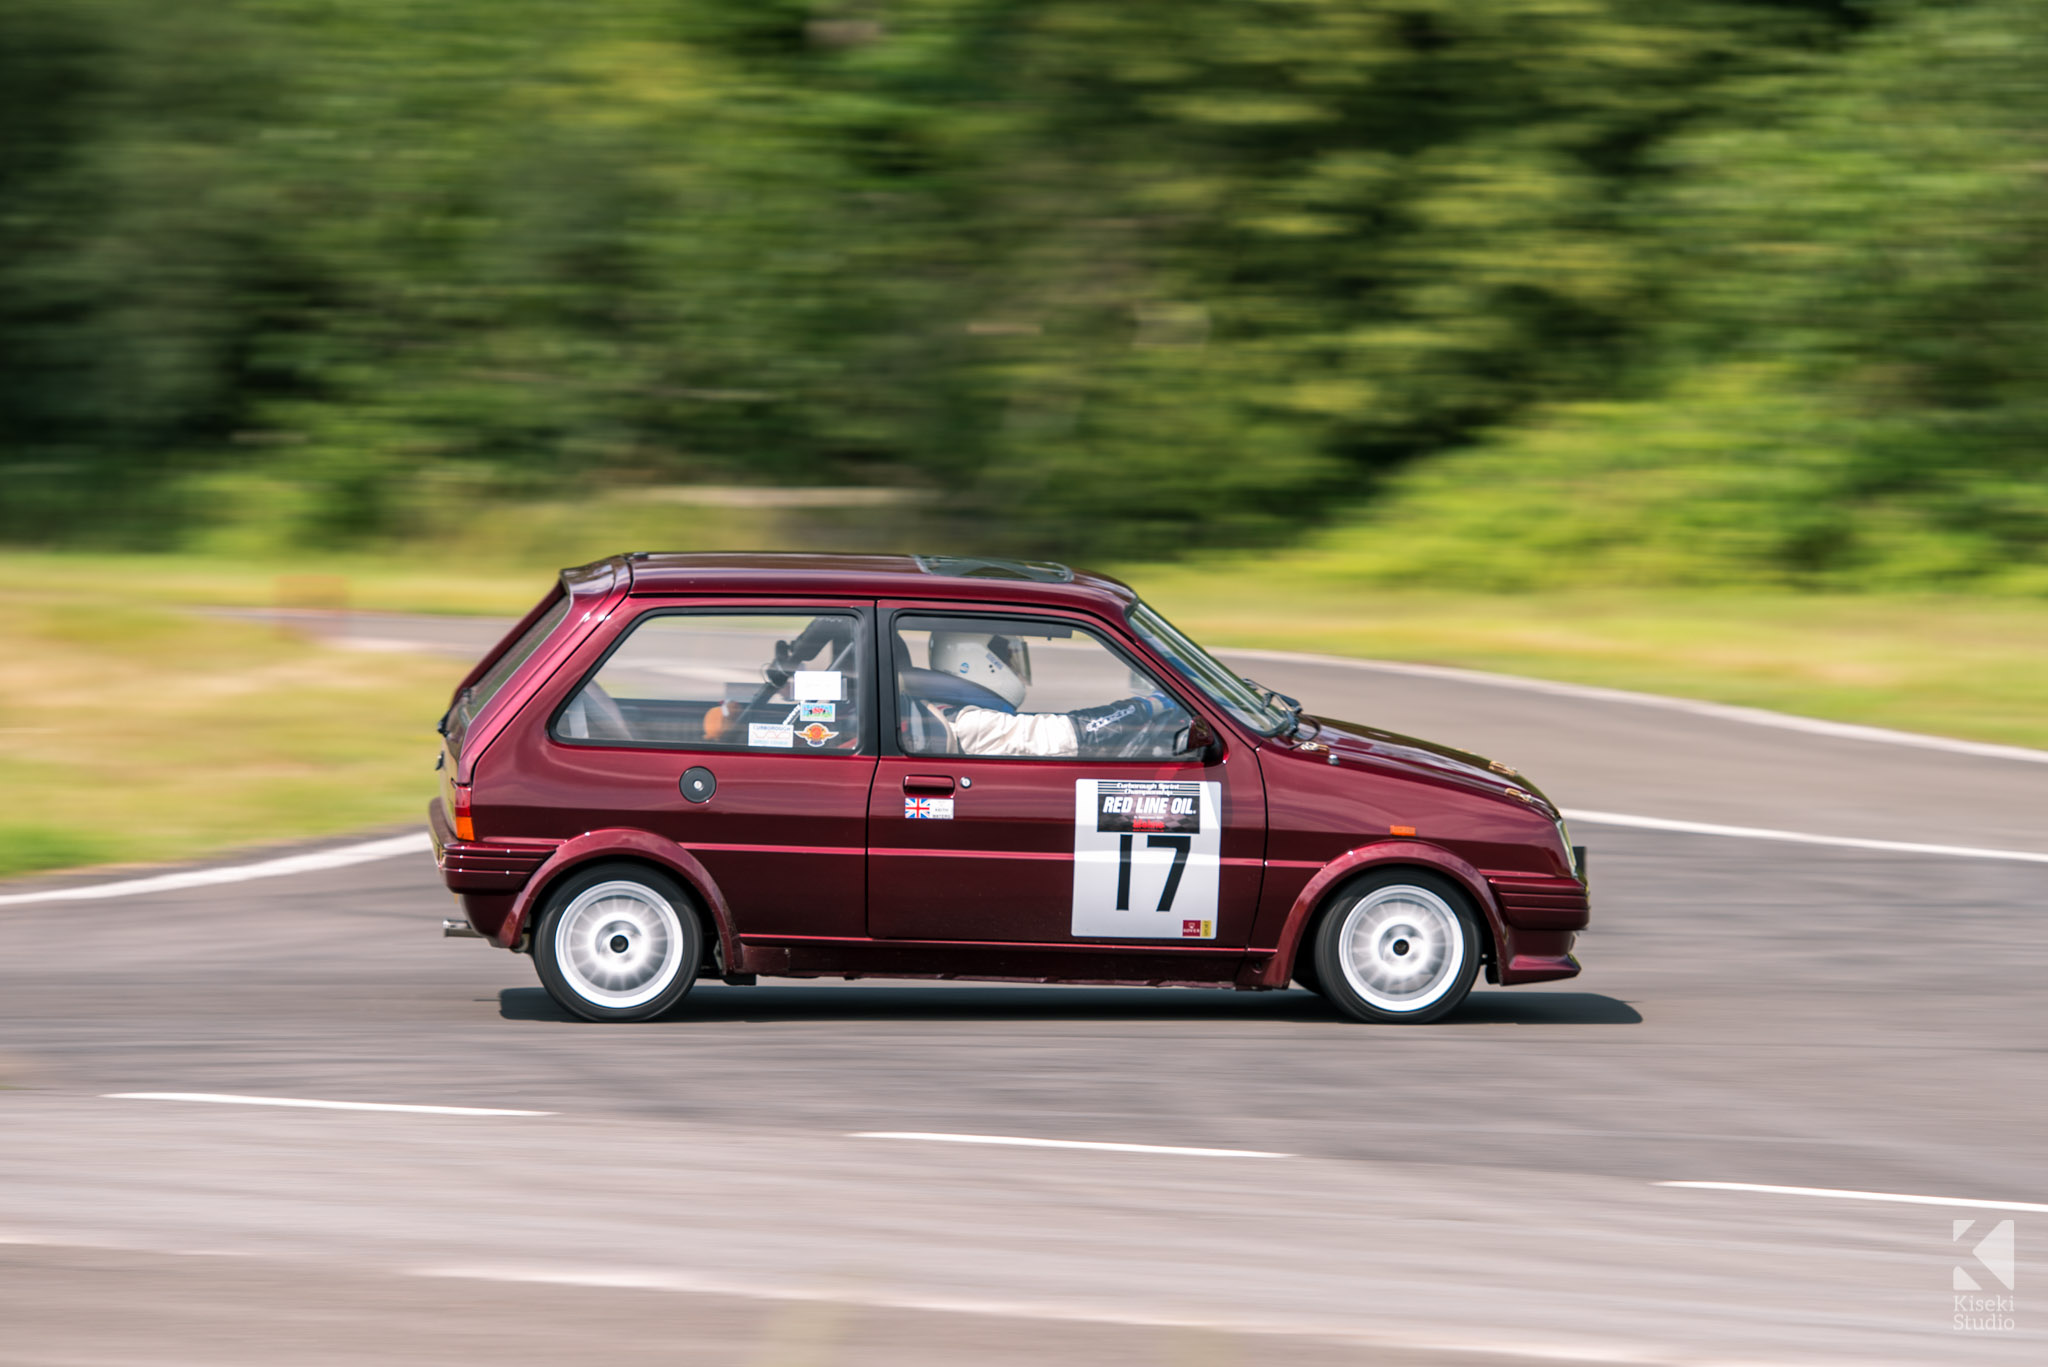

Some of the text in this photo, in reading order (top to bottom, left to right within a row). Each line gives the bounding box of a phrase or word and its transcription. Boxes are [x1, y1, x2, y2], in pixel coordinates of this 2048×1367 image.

[1102, 796, 1133, 813] RED
[1135, 796, 1169, 814] LINE
[1116, 834, 1191, 912] 17
